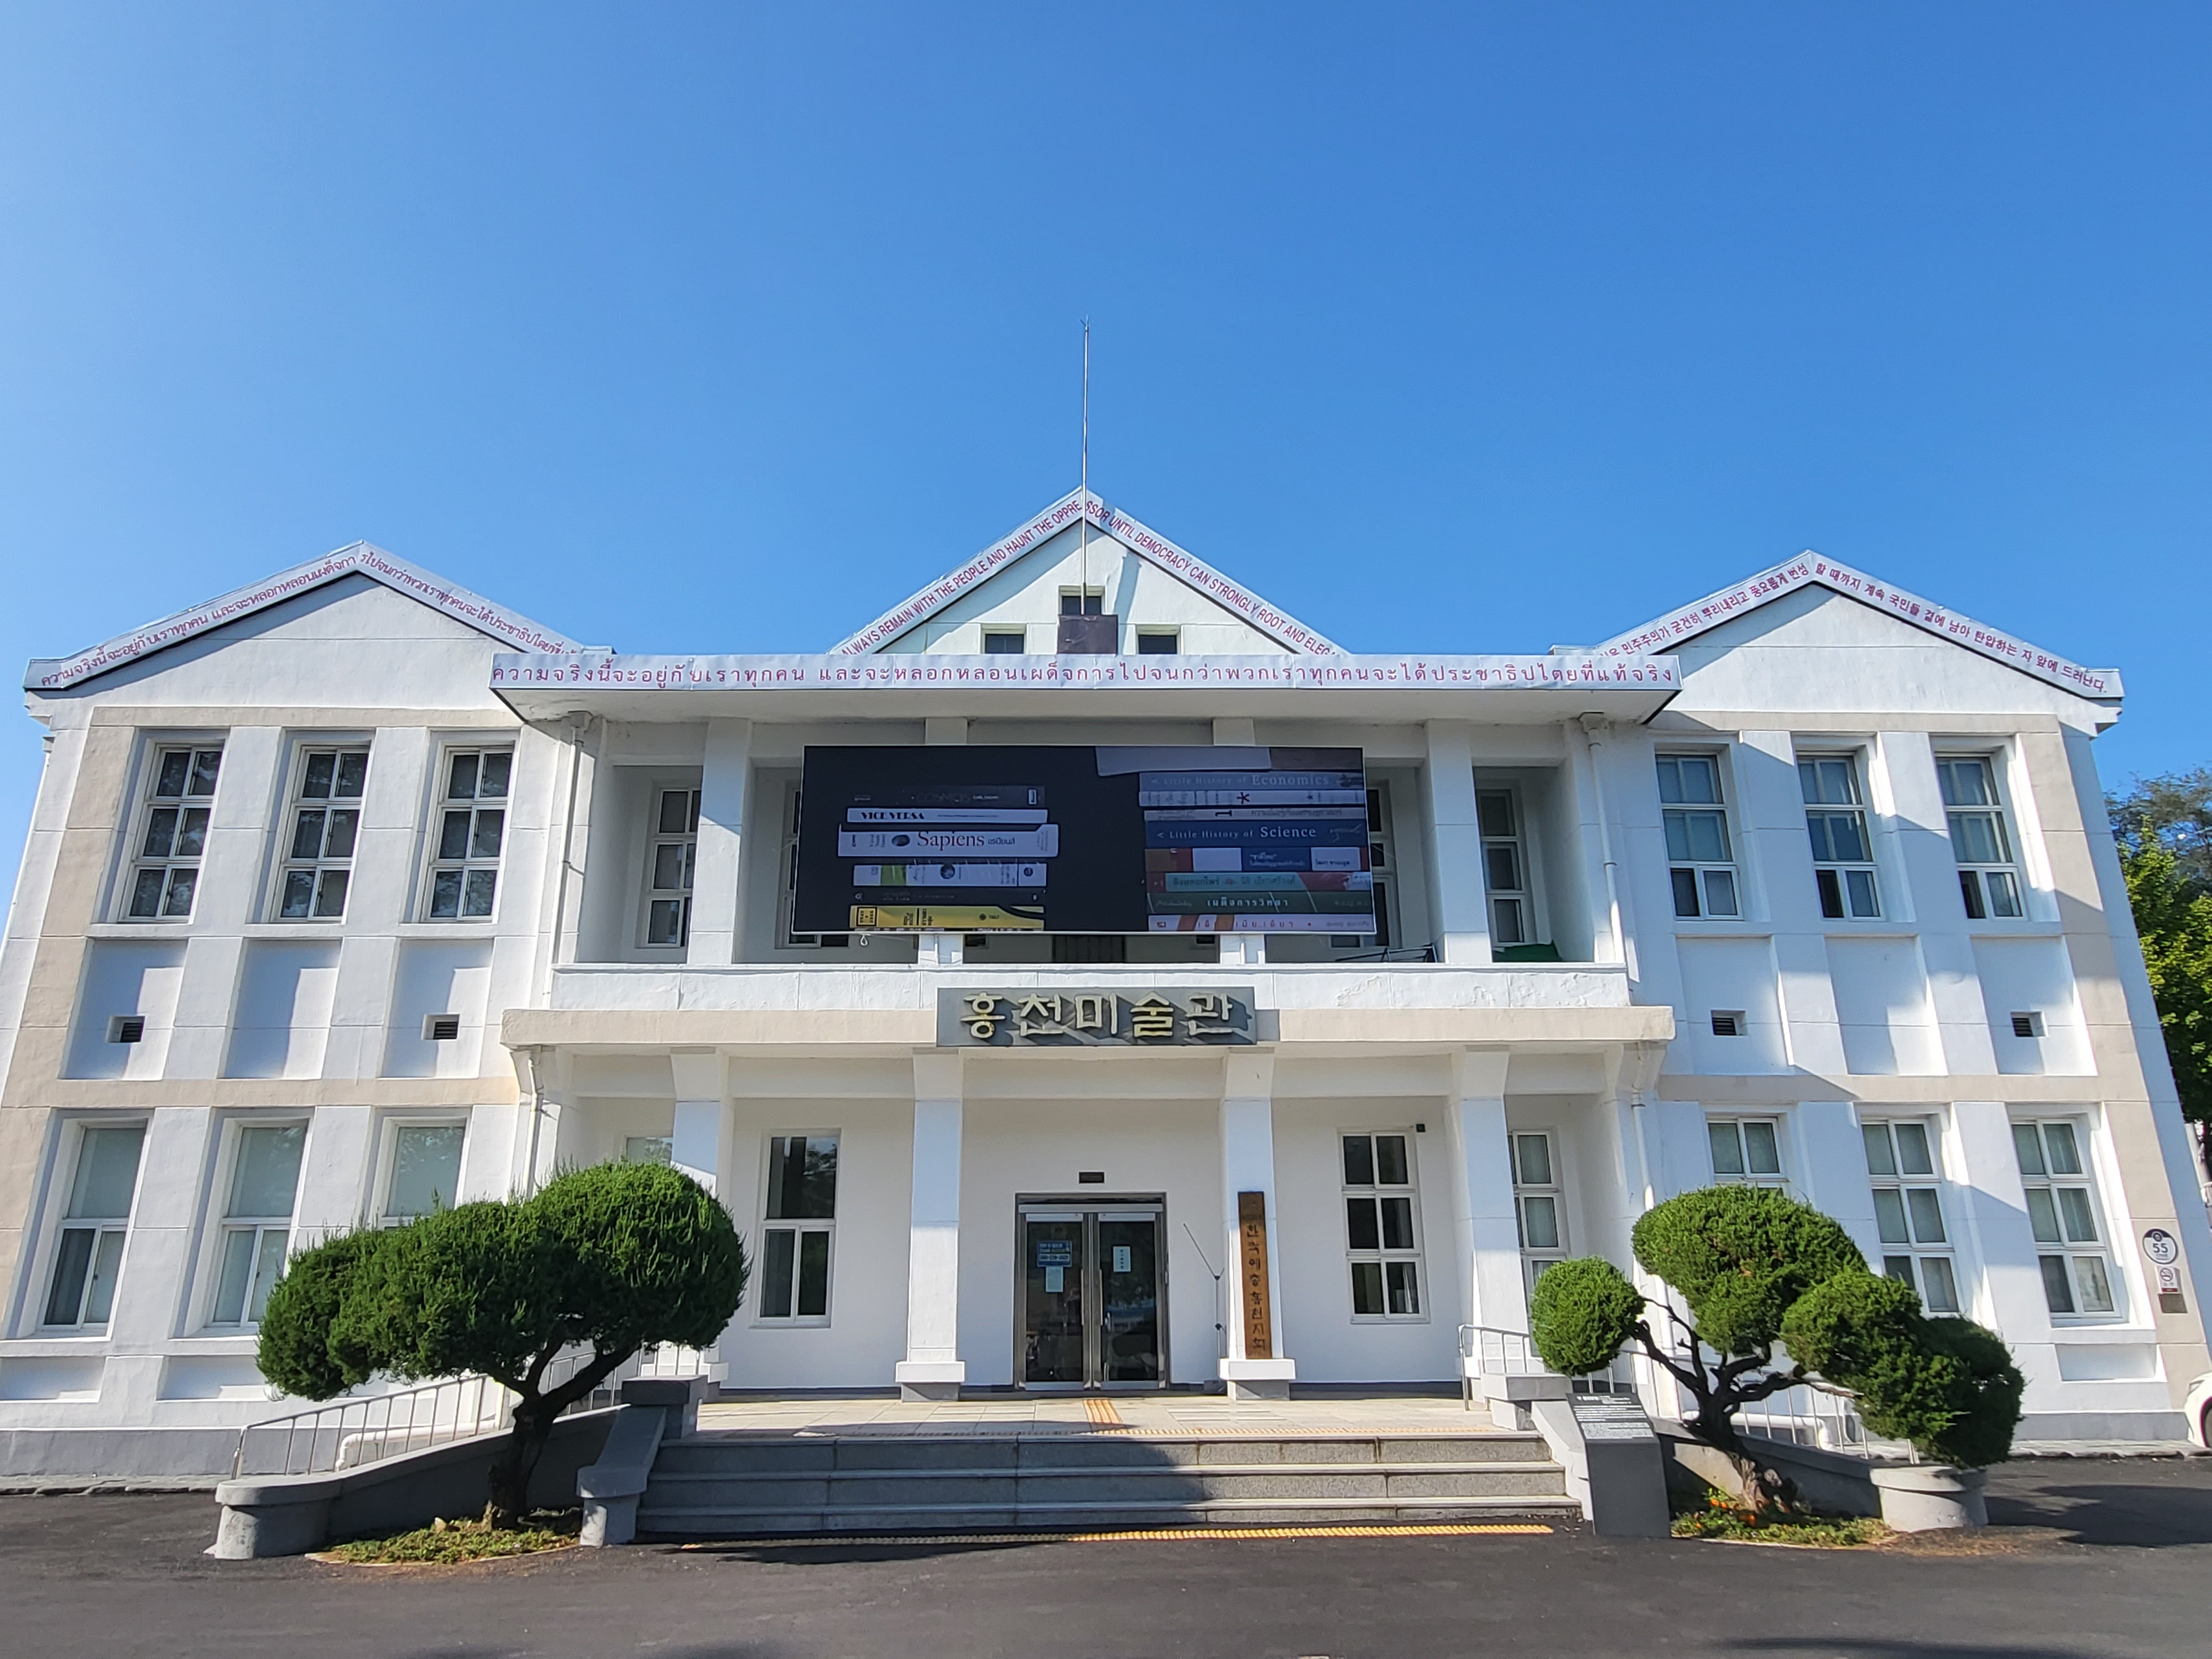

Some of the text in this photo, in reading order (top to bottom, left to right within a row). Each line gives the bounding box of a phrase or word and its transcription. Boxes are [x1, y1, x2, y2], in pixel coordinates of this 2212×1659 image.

[878, 608, 915, 636] REMAIN
[911, 593, 938, 615] WITH
[933, 582, 956, 599] THE
[952, 560, 989, 588] PEOPLE
[986, 549, 1006, 567] AND
[1004, 529, 1036, 555] HAUNT
[1032, 518, 1055, 535] THE
[1108, 515, 1135, 539] UNTIL
[1134, 532, 1192, 572] DEMOCRACY
[1190, 567, 1211, 585] CAN
[1209, 578, 1260, 614] STRONGLY
[1256, 608, 1286, 630] ROOT
[1283, 625, 1305, 643] AND
[1304, 637, 1336, 655] ELEG
[1621, 625, 1671, 655] 민주주의가
[1670, 612, 1703, 634] 굳건히
[1701, 591, 1750, 619] 뿌리내리고
[1749, 572, 1790, 598] 풍요롭게
[1829, 568, 1861, 590] 때까지
[1864, 583, 1885, 601] 계속
[1889, 594, 1921, 616] 국민들
[1949, 620, 1970, 637] 남아
[1974, 630, 2018, 656] 탄압하는
[2021, 649, 2032, 662] 자
[2036, 655, 2058, 672] 앞에
[2060, 665, 2107, 693] 드러난다.
[492, 658, 805, 687] ความจริงนี้จะอยู่กับเราทุกคน
[1252, 774, 1329, 786] Economics
[917, 831, 984, 851] Sapiens
[1170, 831, 1197, 839] Little
[1202, 830, 1238, 839] History
[1260, 826, 1317, 838] Science
[962, 992, 1234, 1039] 홍천미술관
[2152, 1243, 2169, 1254] 55
